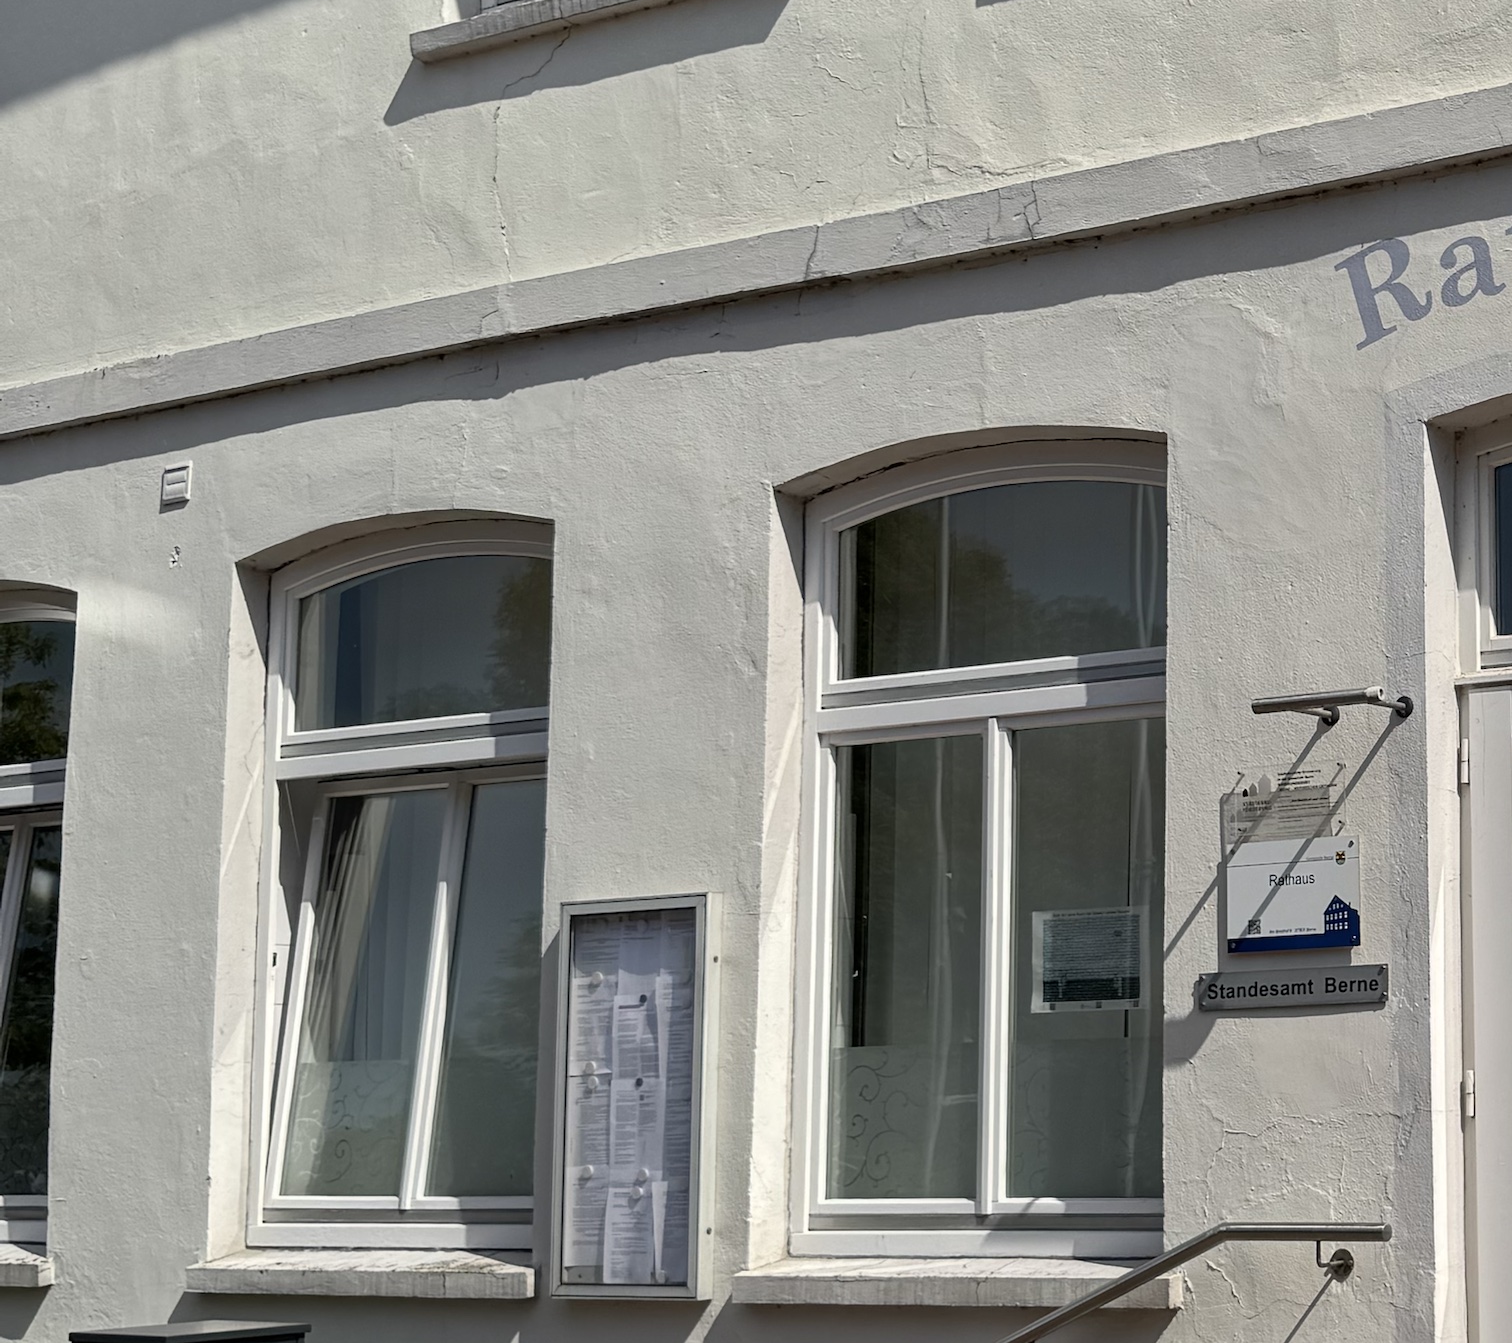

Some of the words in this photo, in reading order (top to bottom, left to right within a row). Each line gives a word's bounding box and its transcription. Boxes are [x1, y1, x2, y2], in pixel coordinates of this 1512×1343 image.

[1268, 873, 1316, 887] Rathaus
[1207, 981, 1314, 1000] Standesamt
[1324, 977, 1379, 994] Berne
